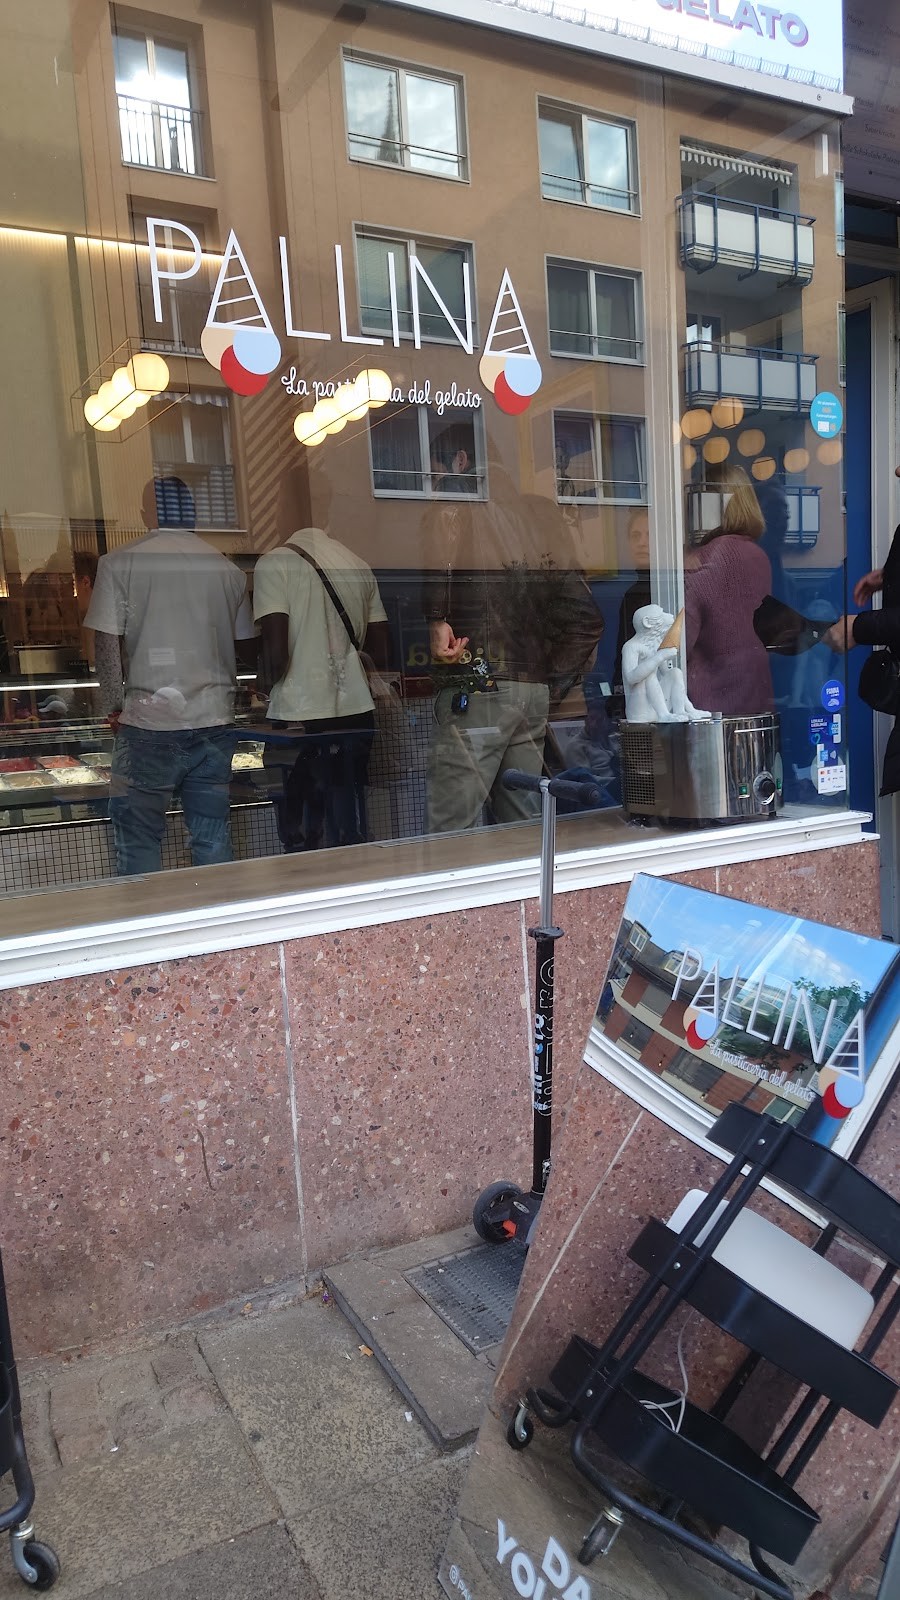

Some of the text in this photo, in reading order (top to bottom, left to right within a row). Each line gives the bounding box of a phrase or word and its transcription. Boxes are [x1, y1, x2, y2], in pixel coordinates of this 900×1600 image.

[146, 217, 535, 360] PALLINA
[281, 367, 309, 395] La
[408, 379, 432, 405] del
[435, 382, 482, 416] gelato
[671, 947, 865, 1083] PALLINA
[769, 1069, 788, 1088] del
[784, 1078, 817, 1102] gelato
